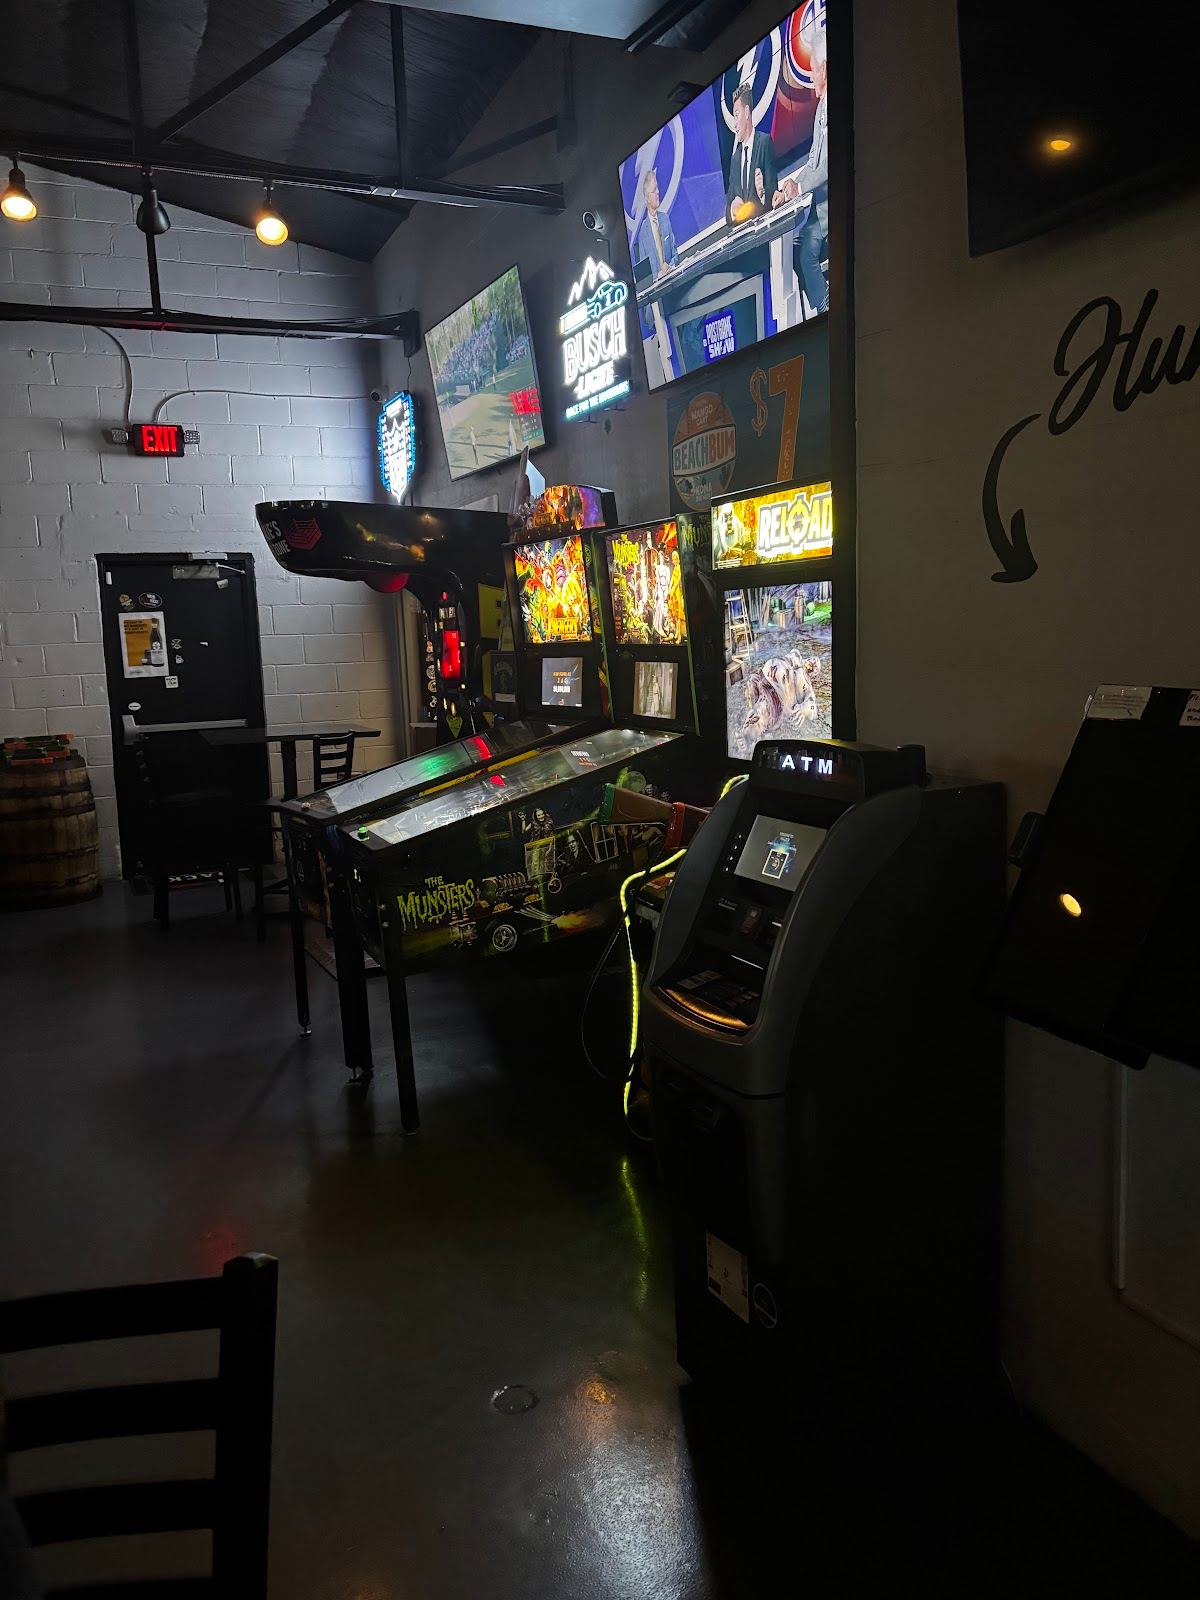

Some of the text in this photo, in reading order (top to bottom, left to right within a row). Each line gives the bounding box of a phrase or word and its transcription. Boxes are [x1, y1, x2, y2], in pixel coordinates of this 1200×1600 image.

[562, 307, 627, 386] BUSCH
[141, 425, 178, 453] EXIT
[781, 754, 833, 776] ATM
[425, 875, 445, 889] THE
[397, 879, 477, 932] MUNSTERS
